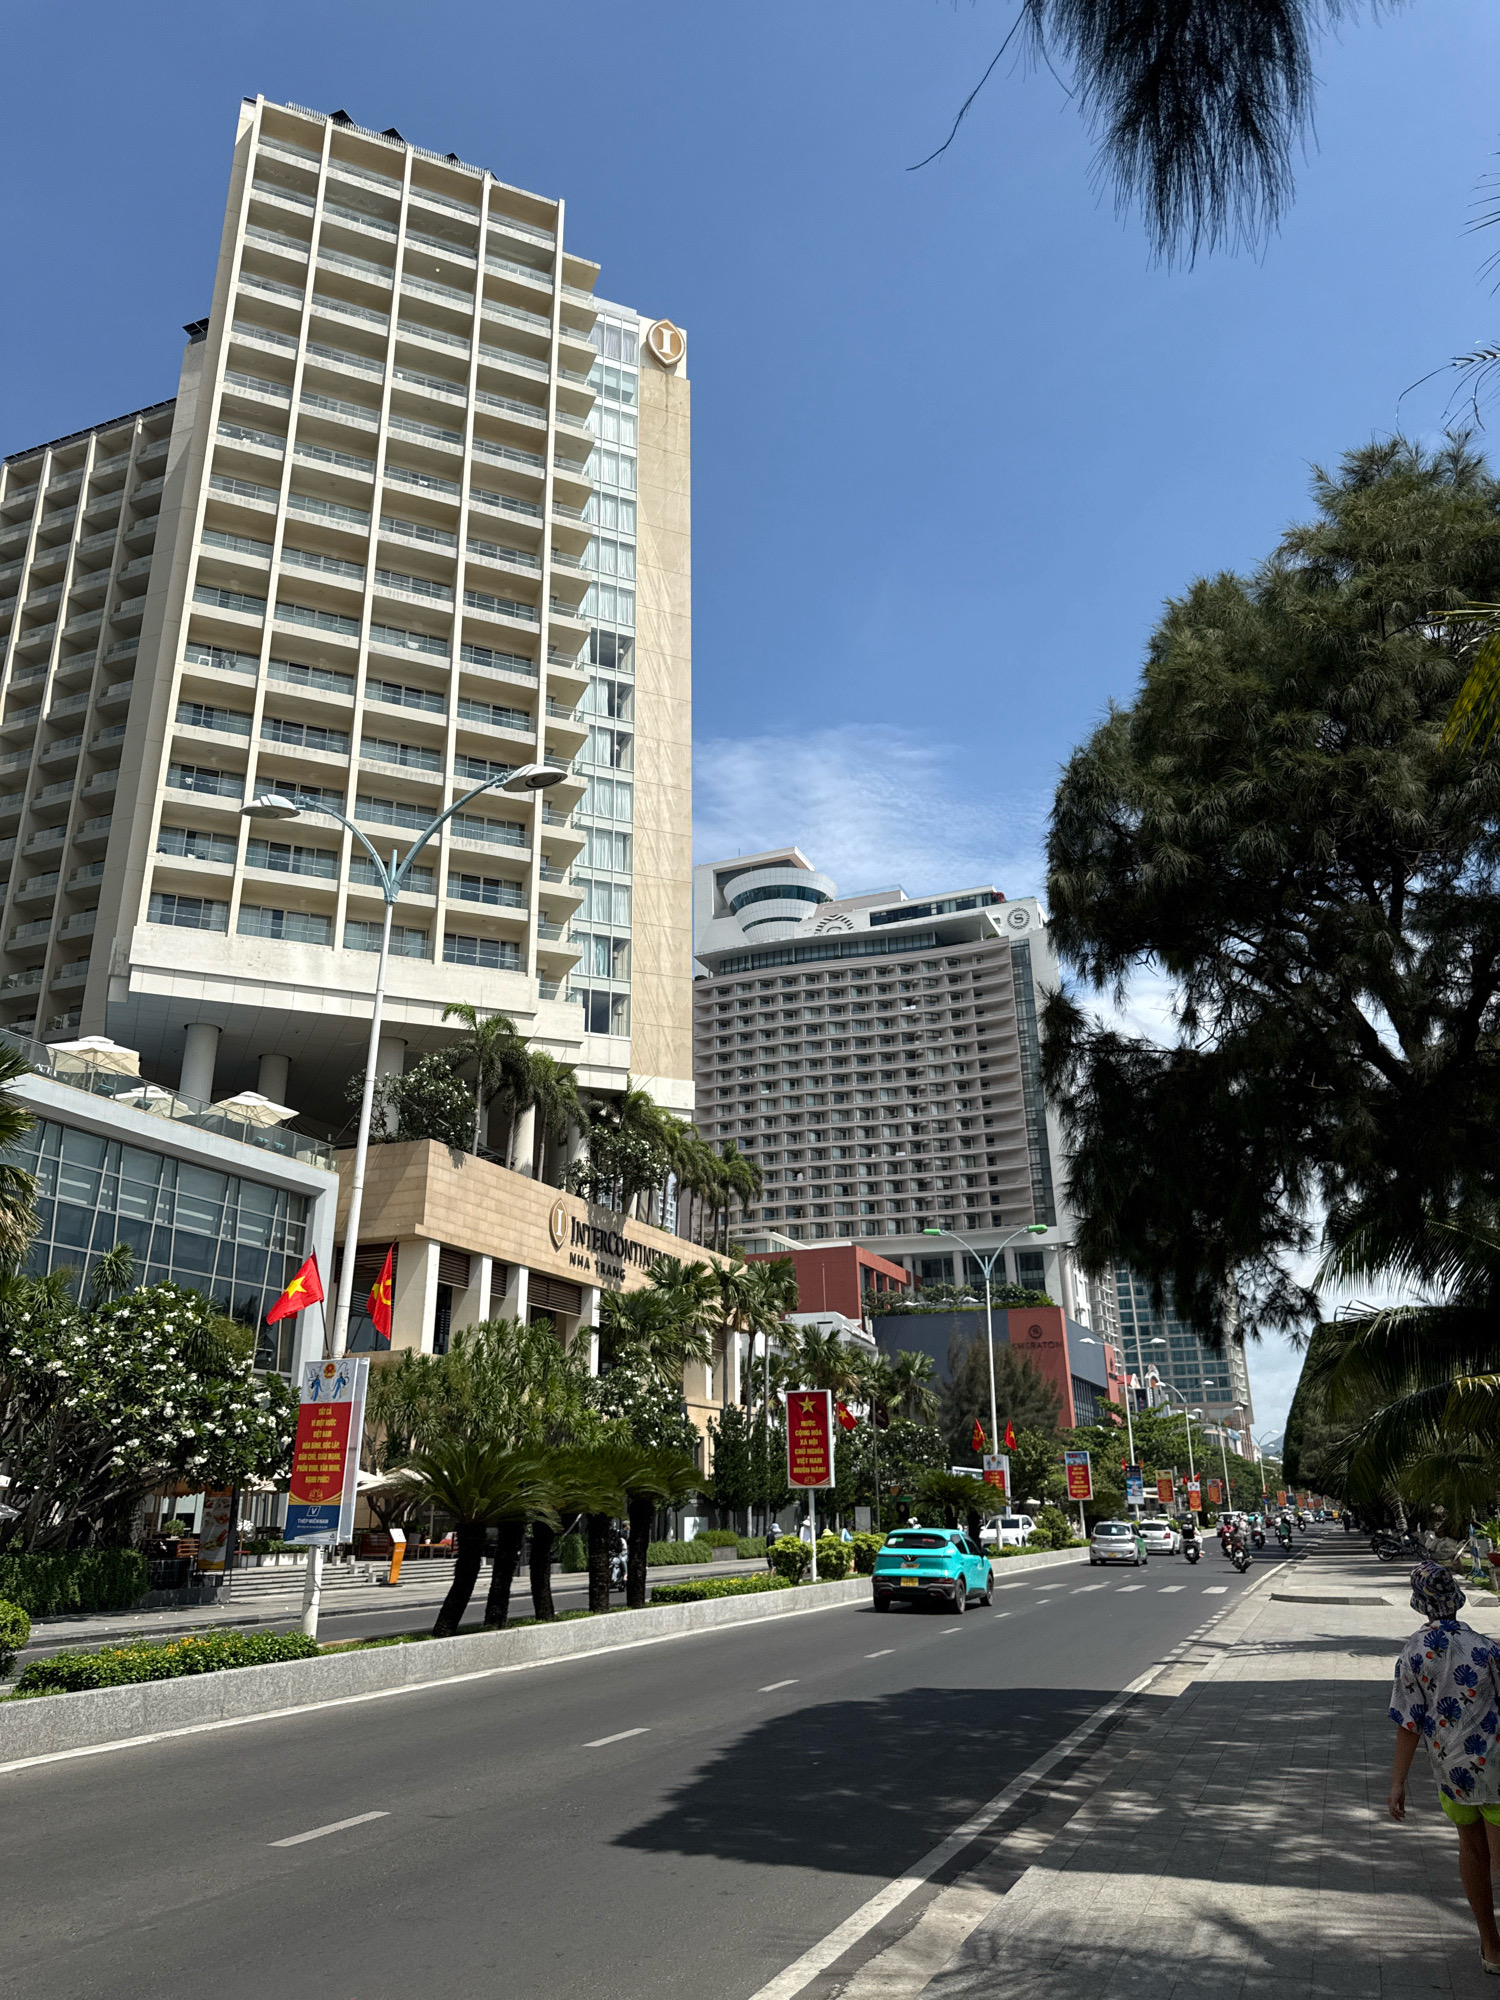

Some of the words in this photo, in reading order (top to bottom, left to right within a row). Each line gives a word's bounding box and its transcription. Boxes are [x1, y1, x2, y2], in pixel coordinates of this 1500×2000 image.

[570, 1216, 681, 1270] INTERCONTIN
[569, 1252, 590, 1270] NHA
[594, 1260, 626, 1281] TRANG
[794, 1429, 810, 1437] CỘNG
[797, 1457, 808, 1465] VIỆT
